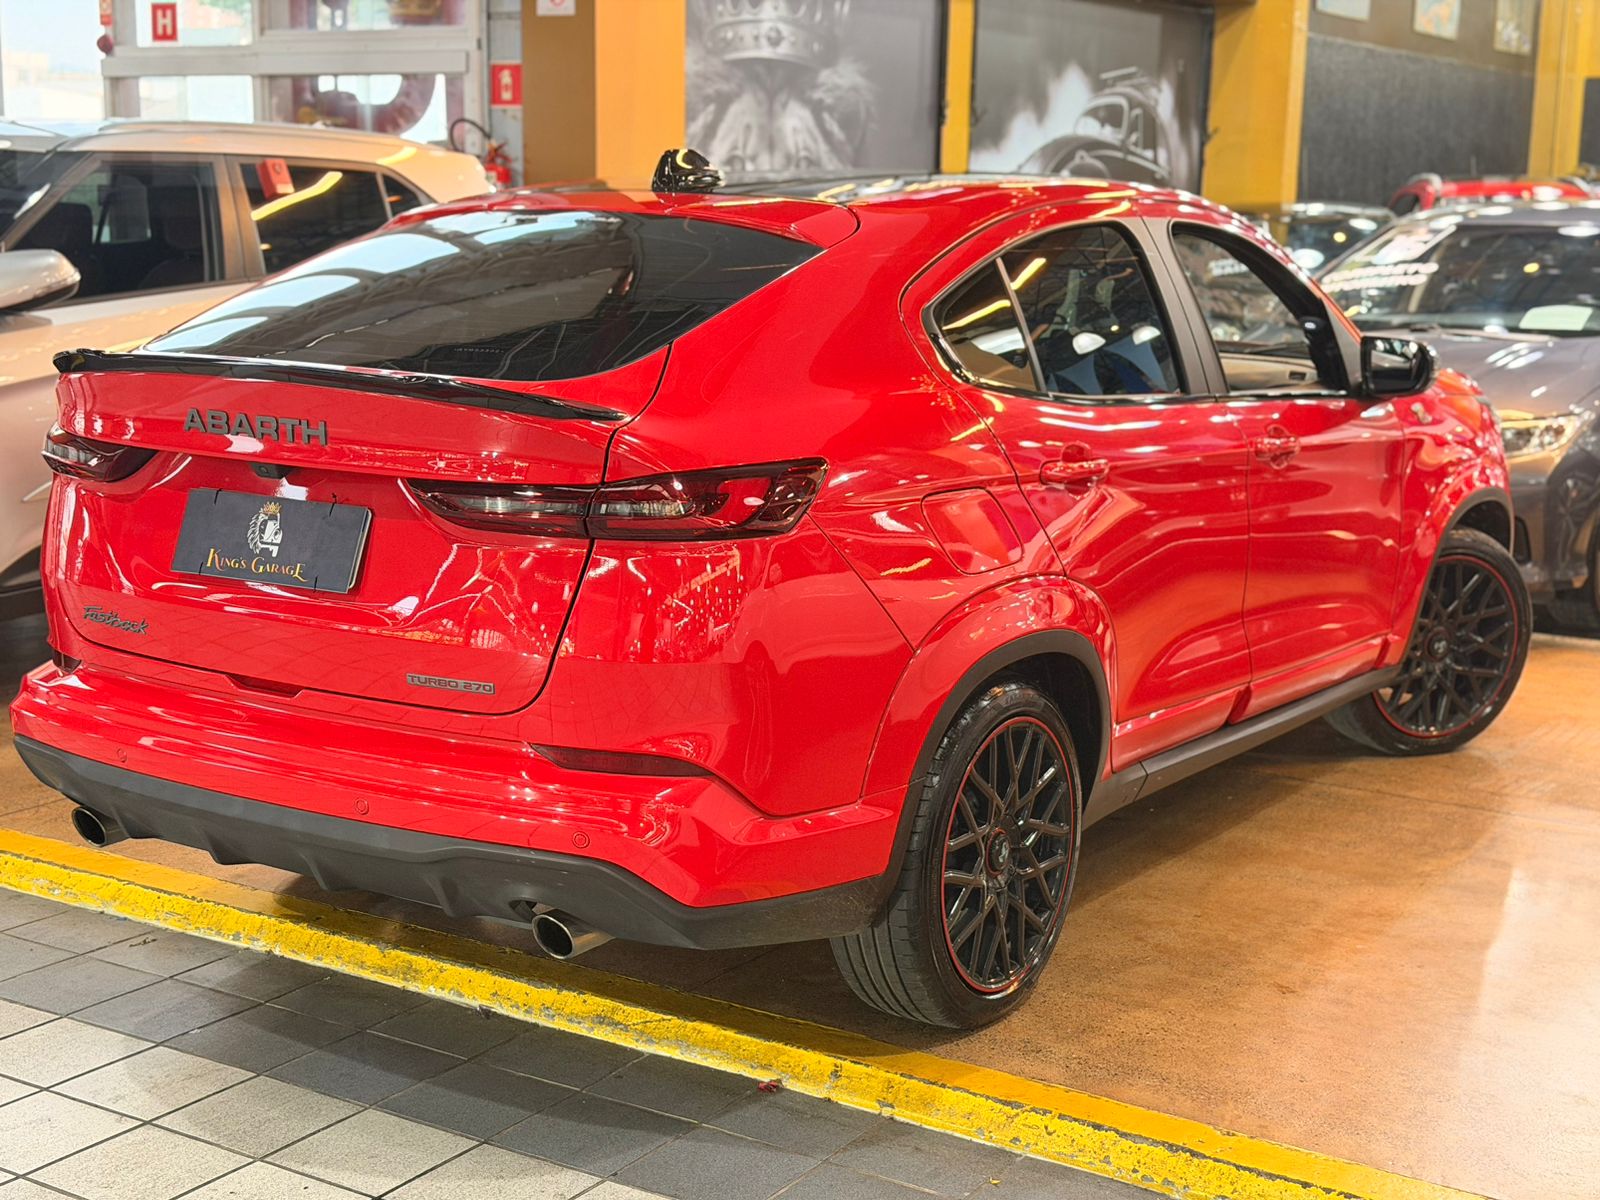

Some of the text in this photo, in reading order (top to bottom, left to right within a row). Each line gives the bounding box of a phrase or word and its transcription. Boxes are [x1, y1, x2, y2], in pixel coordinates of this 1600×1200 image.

[156, 9, 173, 36] H
[184, 407, 328, 446] ABARTH
[83, 606, 149, 635] Fastback
[407, 674, 493, 693] TURBO 270
